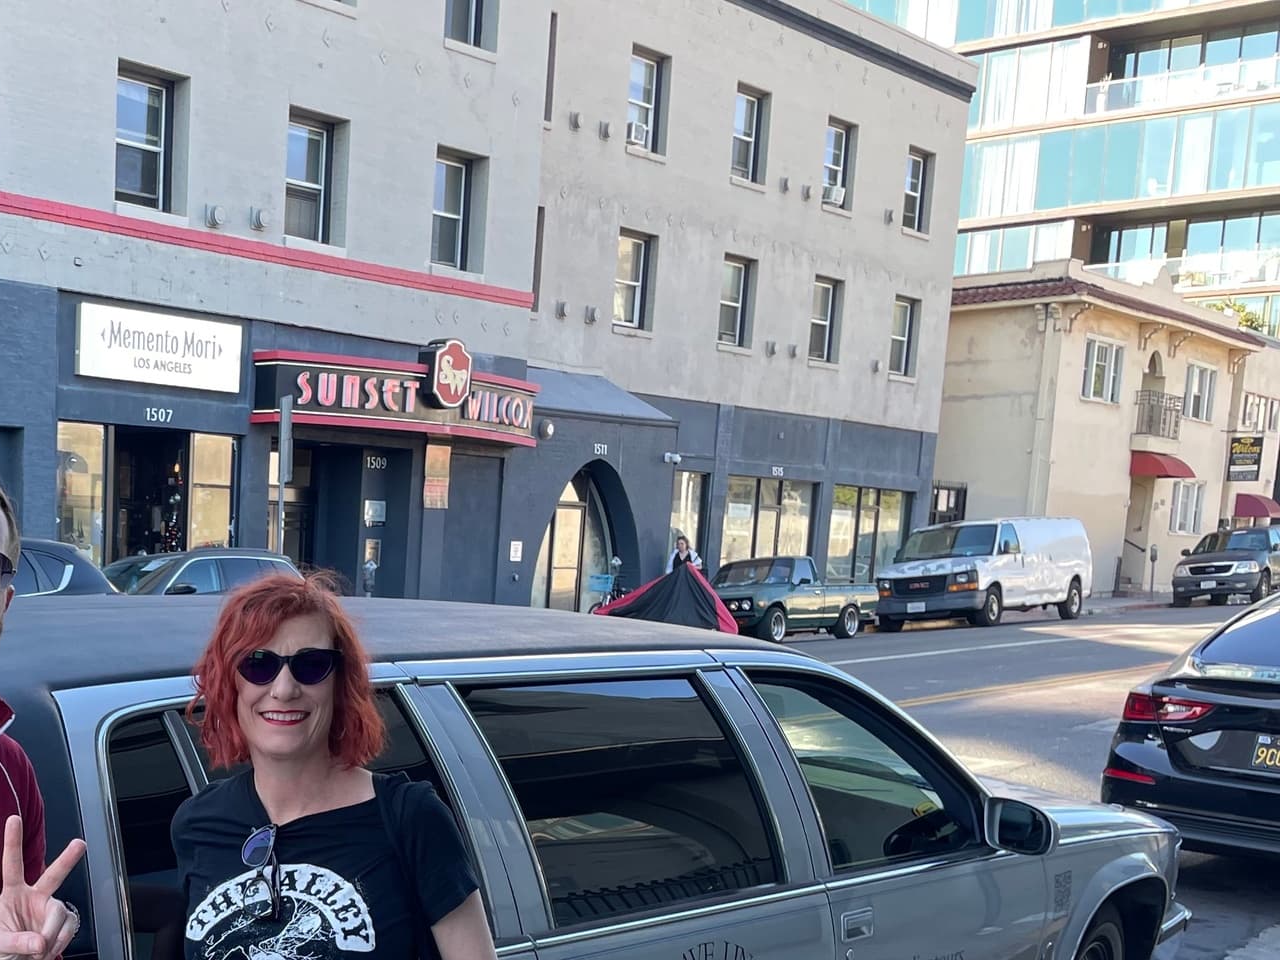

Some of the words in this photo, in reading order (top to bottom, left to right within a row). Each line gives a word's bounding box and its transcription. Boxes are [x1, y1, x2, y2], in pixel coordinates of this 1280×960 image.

[107, 319, 179, 354] Memento
[182, 331, 216, 359] Mori
[134, 357, 151, 370] LOS
[153, 359, 192, 374] ANGELES
[297, 371, 420, 413] SUNSET
[467, 391, 533, 430] WILCOX
[146, 408, 173, 422] 1507
[594, 443, 608, 455] 1511
[367, 456, 387, 469] 1509
[772, 466, 784, 476] 1515
[190, 880, 260, 932] THE
[280, 869, 371, 943] ALLEY
